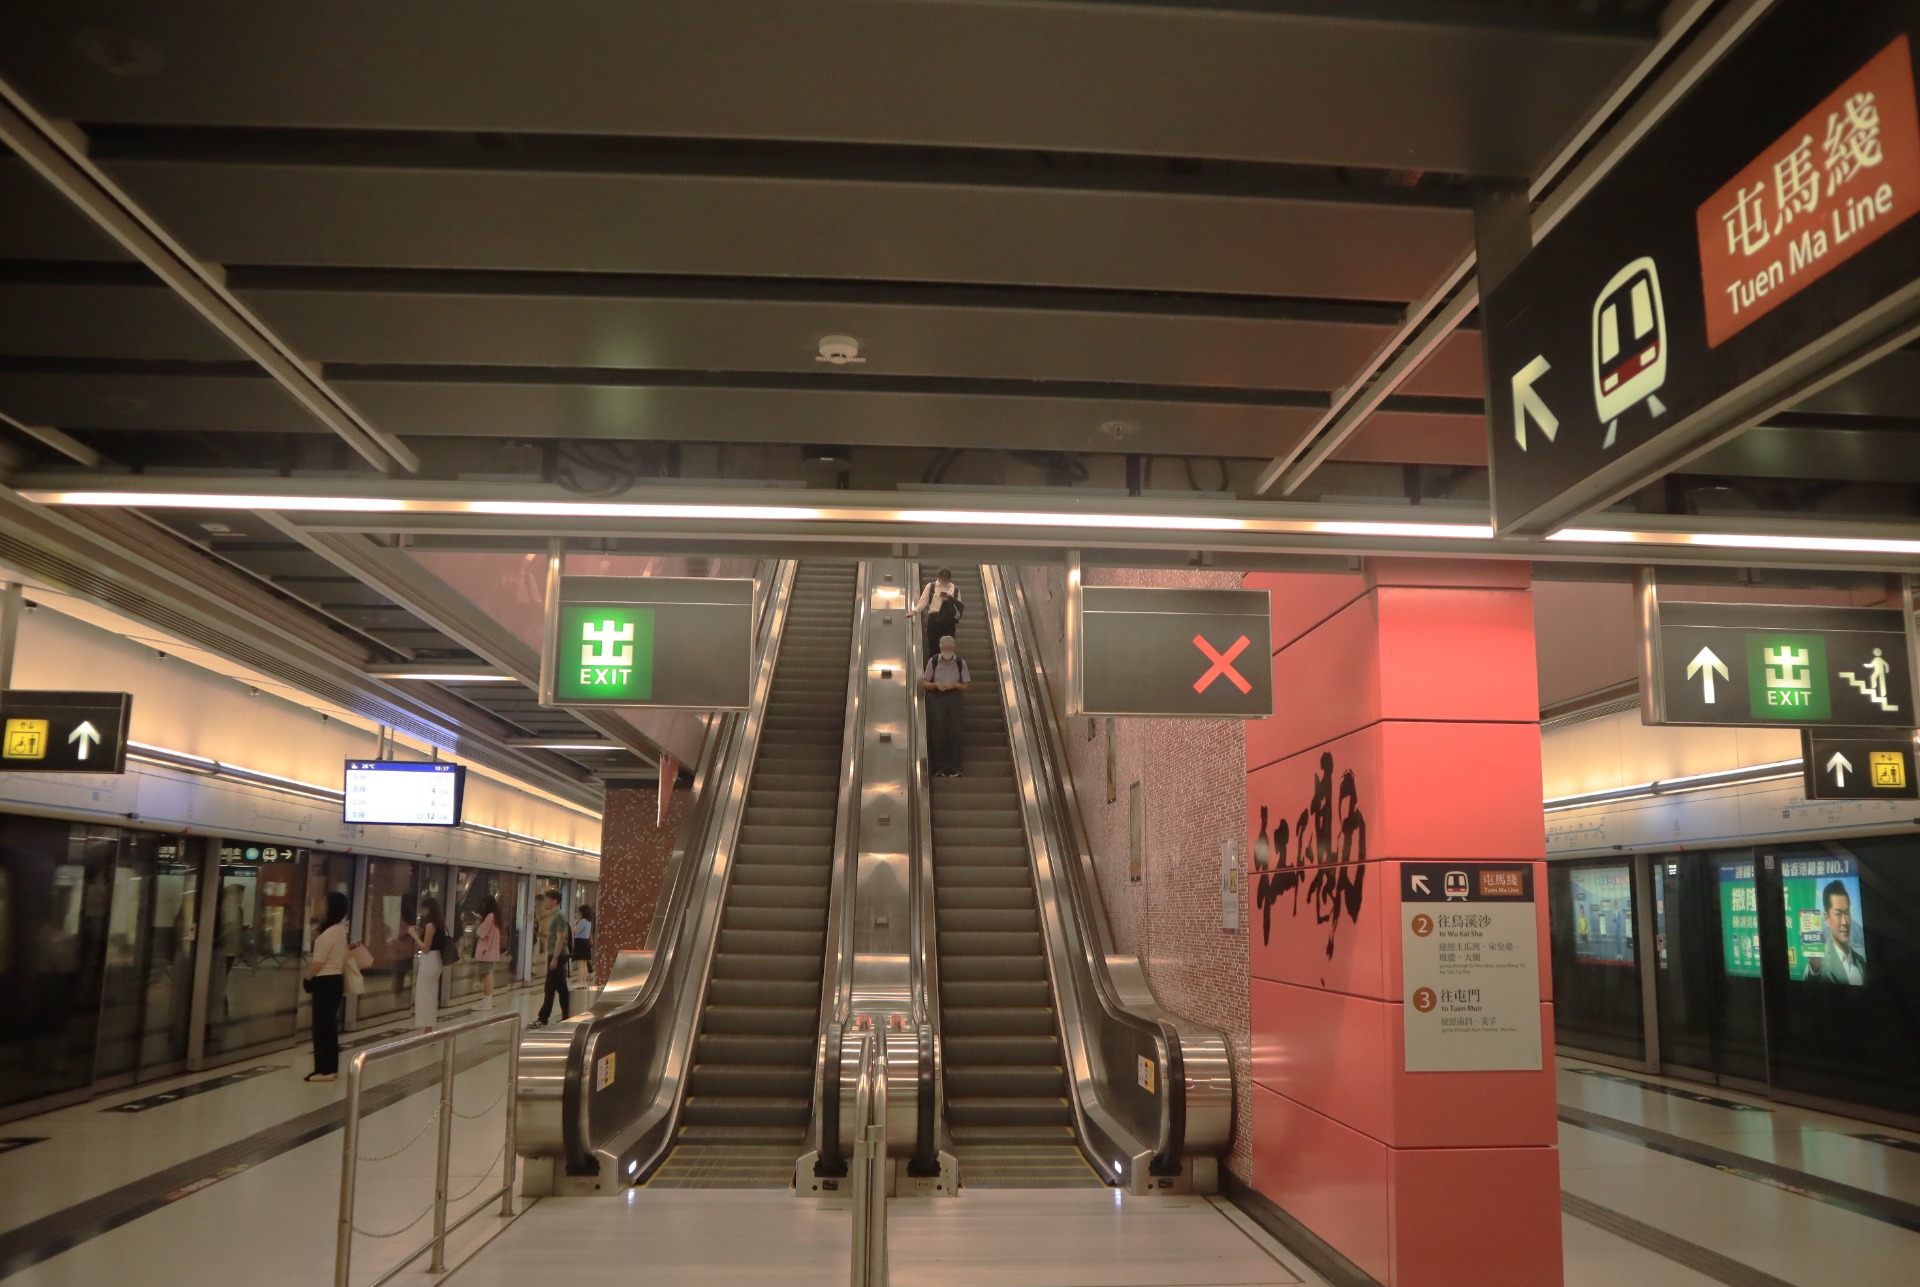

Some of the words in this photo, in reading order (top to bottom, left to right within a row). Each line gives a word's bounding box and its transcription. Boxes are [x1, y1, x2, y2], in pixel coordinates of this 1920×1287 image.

[1722, 91, 1883, 256] 屯馬綫
[1726, 259, 1784, 315] Tuen
[1788, 230, 1828, 276] Ma
[1831, 182, 1893, 244] Line
[580, 668, 632, 685] EXIT
[1767, 690, 1812, 706] EXIT
[1418, 917, 1428, 934] 2
[1420, 992, 1430, 1008] 3
[1441, 989, 1480, 1002] 往屯門
